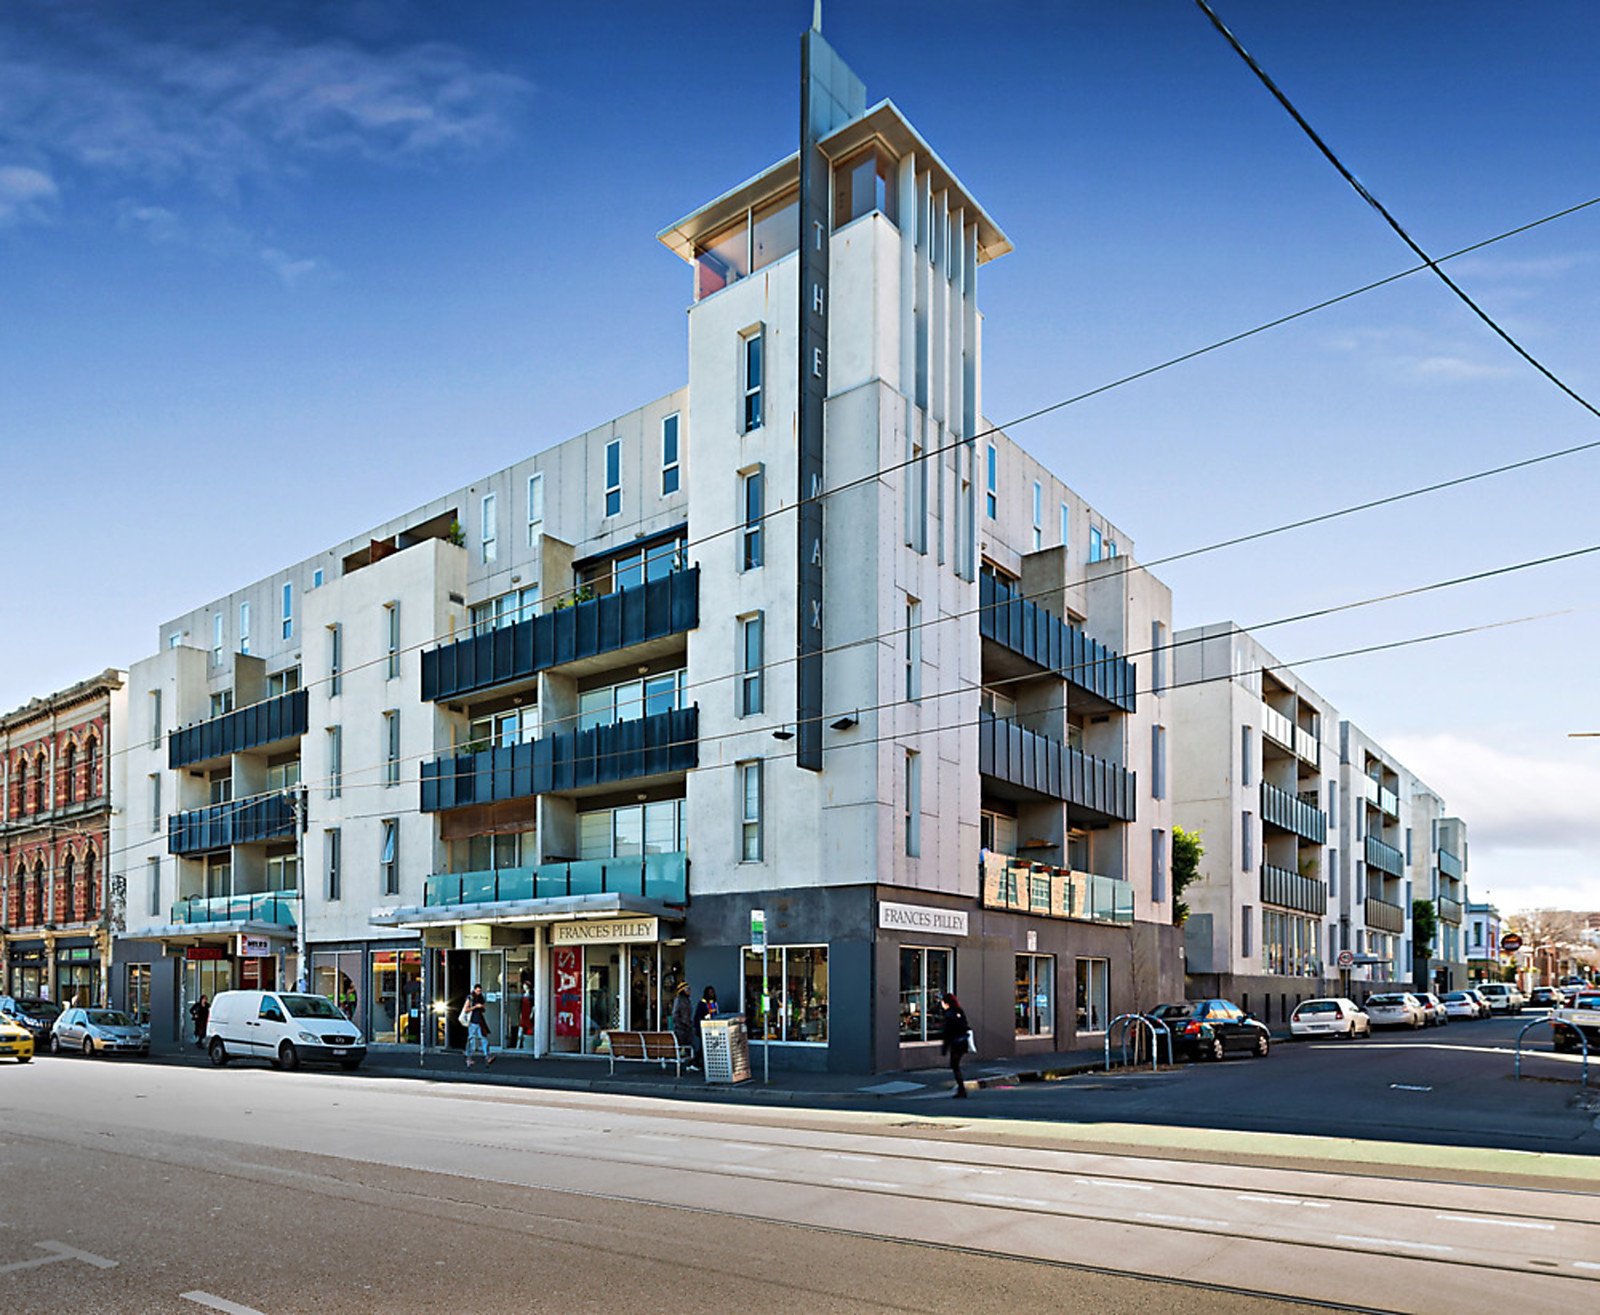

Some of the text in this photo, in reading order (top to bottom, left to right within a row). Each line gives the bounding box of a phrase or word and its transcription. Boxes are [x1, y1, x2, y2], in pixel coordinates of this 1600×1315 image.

[813, 220, 824, 378] THE
[559, 923, 652, 939] FRANCES PILLEY
[884, 908, 965, 930] FRANCES PILLEY
[557, 951, 579, 1027] SALE
